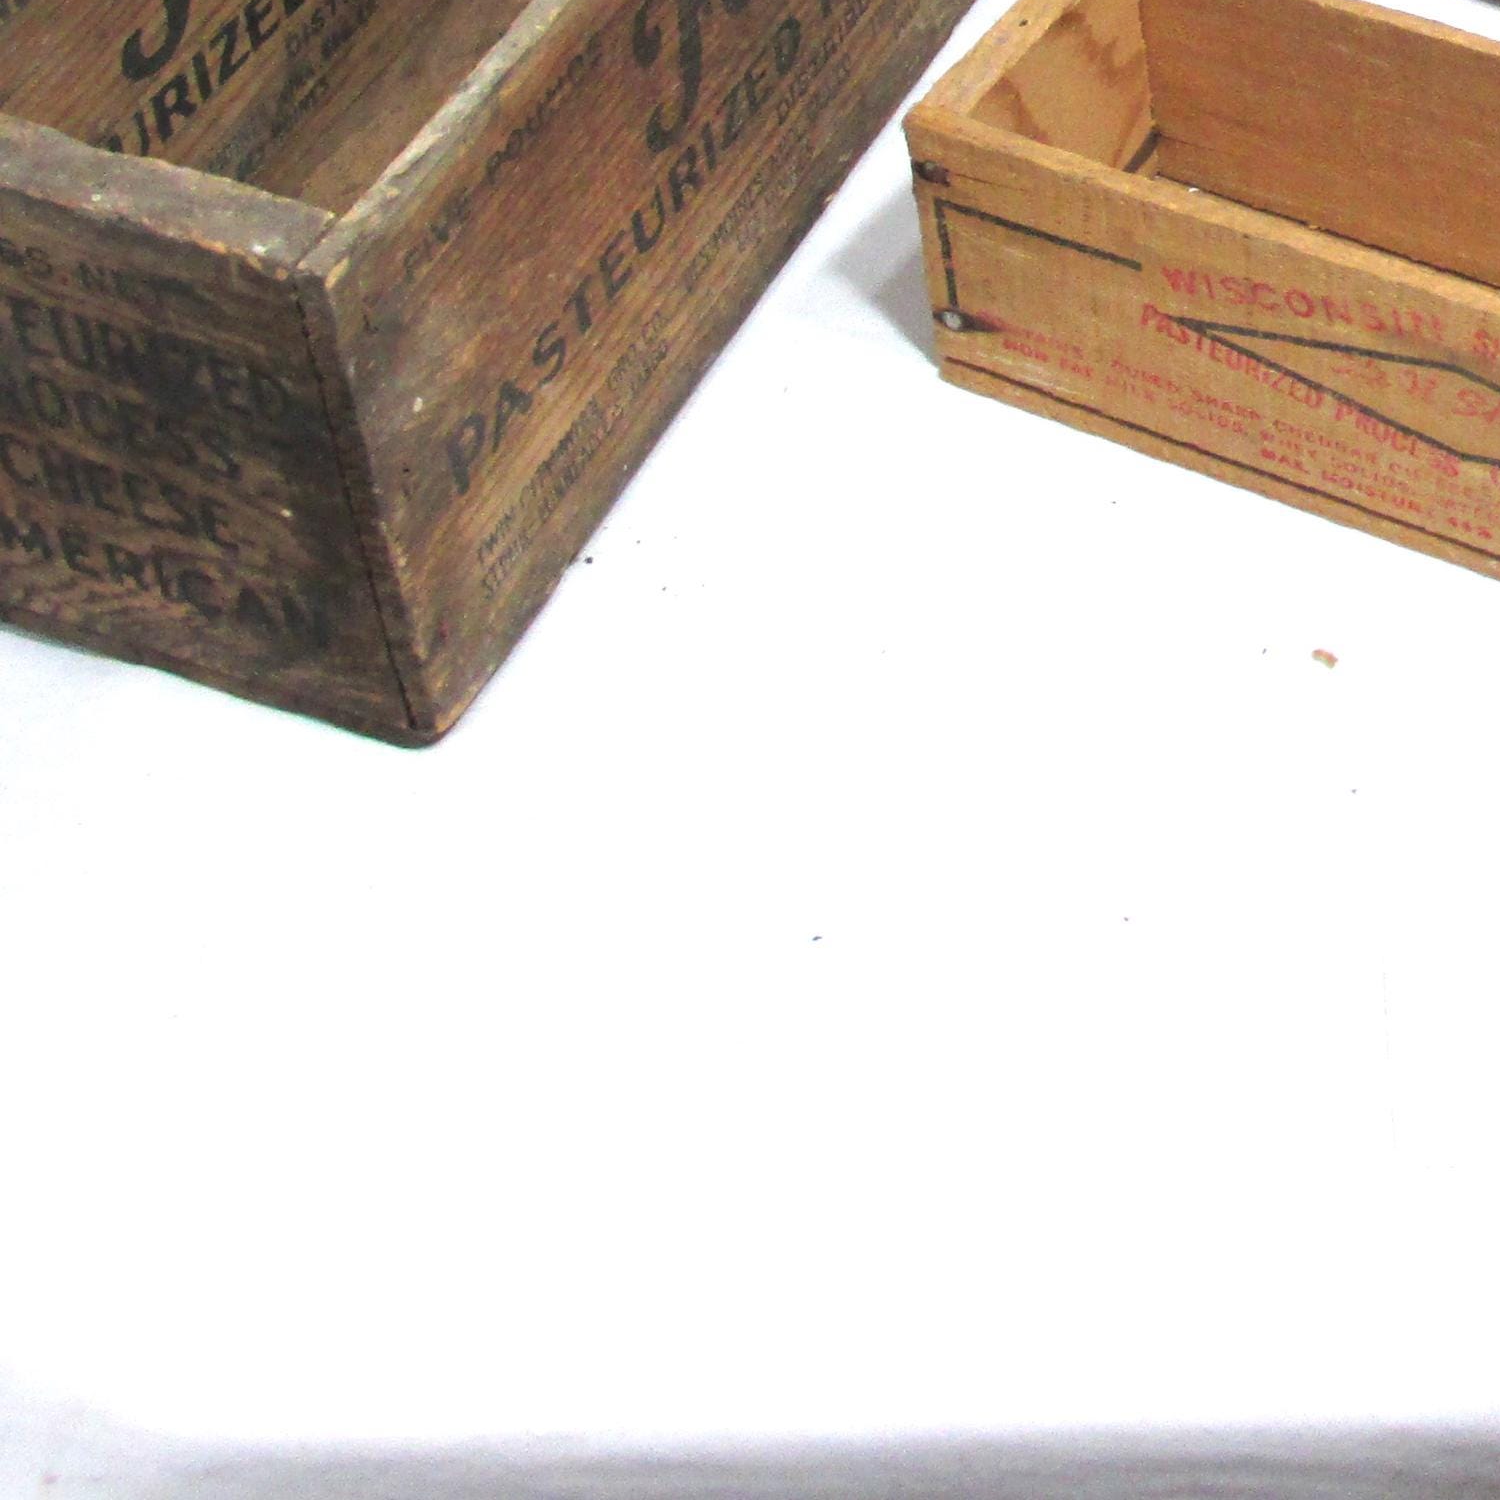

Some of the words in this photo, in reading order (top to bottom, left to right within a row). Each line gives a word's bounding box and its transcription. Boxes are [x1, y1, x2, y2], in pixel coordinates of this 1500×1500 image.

[446, 13, 802, 496] PASTEURIZED
[1160, 264, 1447, 345] WISCONSIN
[1139, 302, 1323, 411] PASTEURIZED
